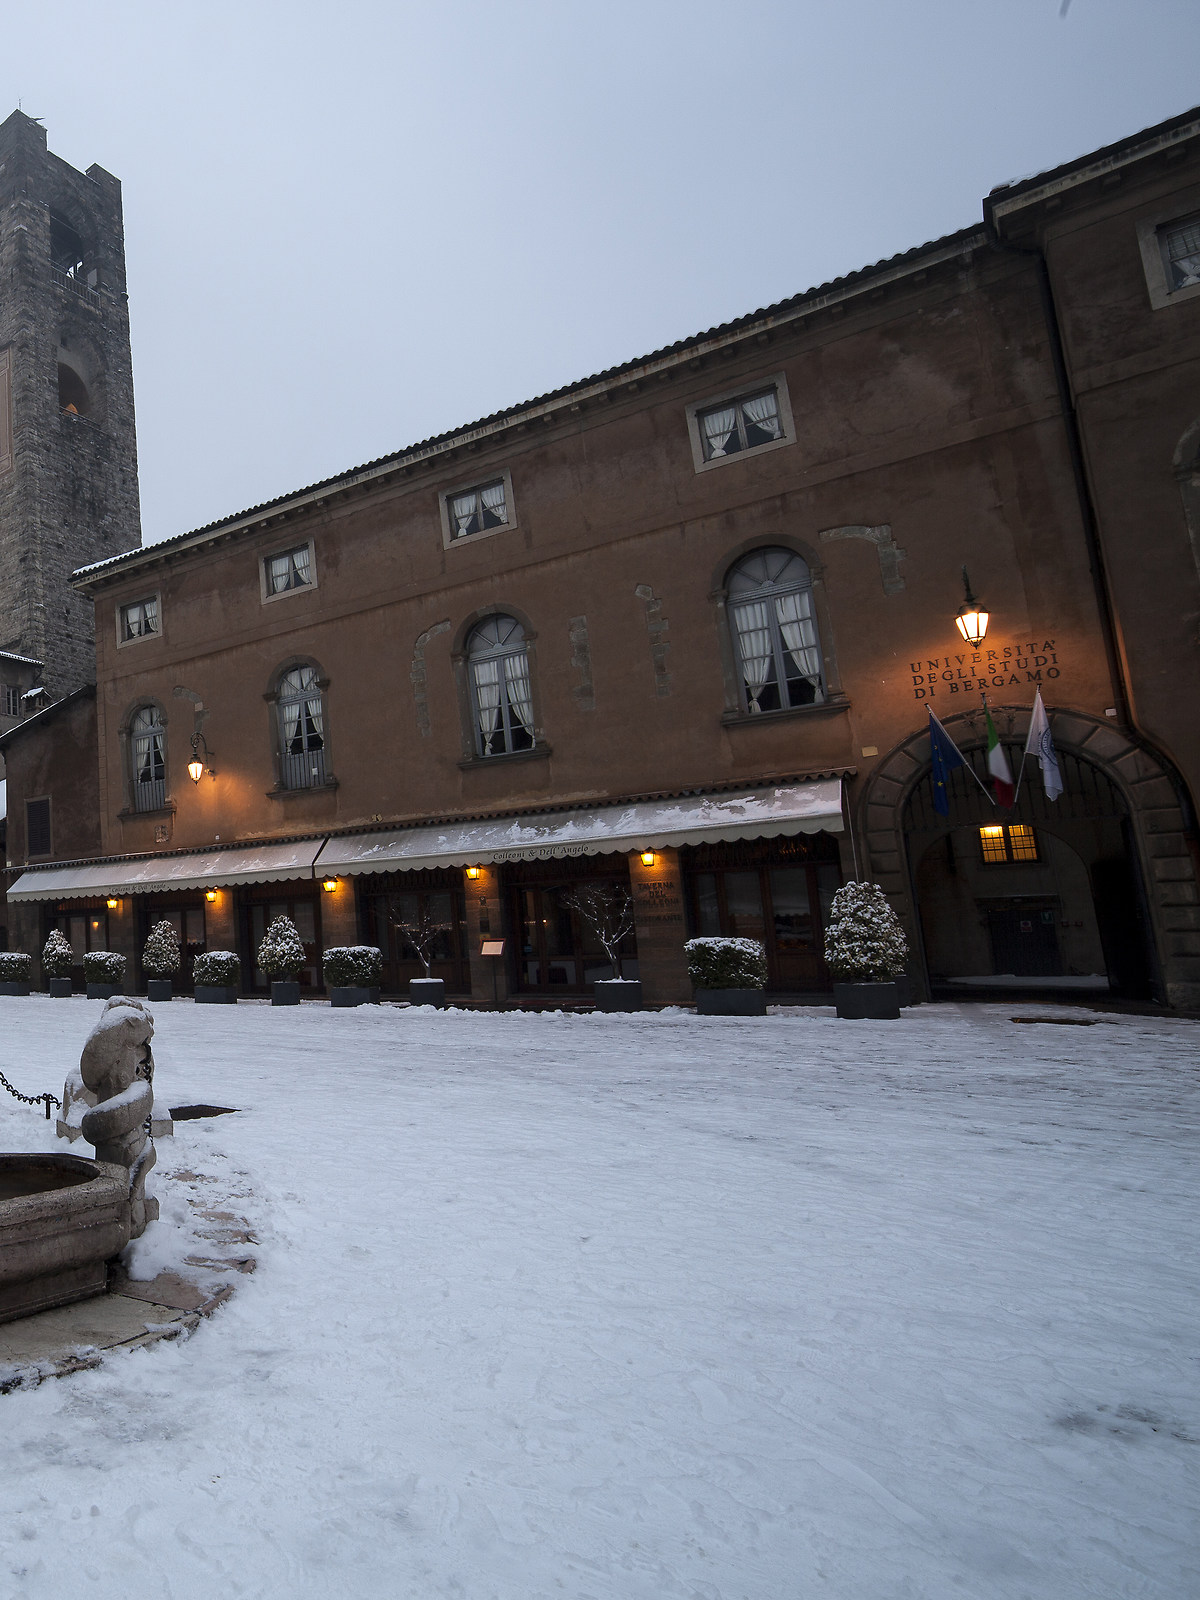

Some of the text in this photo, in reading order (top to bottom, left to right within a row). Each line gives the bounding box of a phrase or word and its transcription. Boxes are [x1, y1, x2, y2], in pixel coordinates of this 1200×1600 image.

[912, 653, 1059, 687] DEGLI STUDI
[914, 667, 1061, 699] DI BERGAMO
[493, 850, 525, 860] Colleoni
[528, 849, 537, 857] &
[637, 882, 674, 890] TAVERNA
[649, 890, 666, 898] DEL
